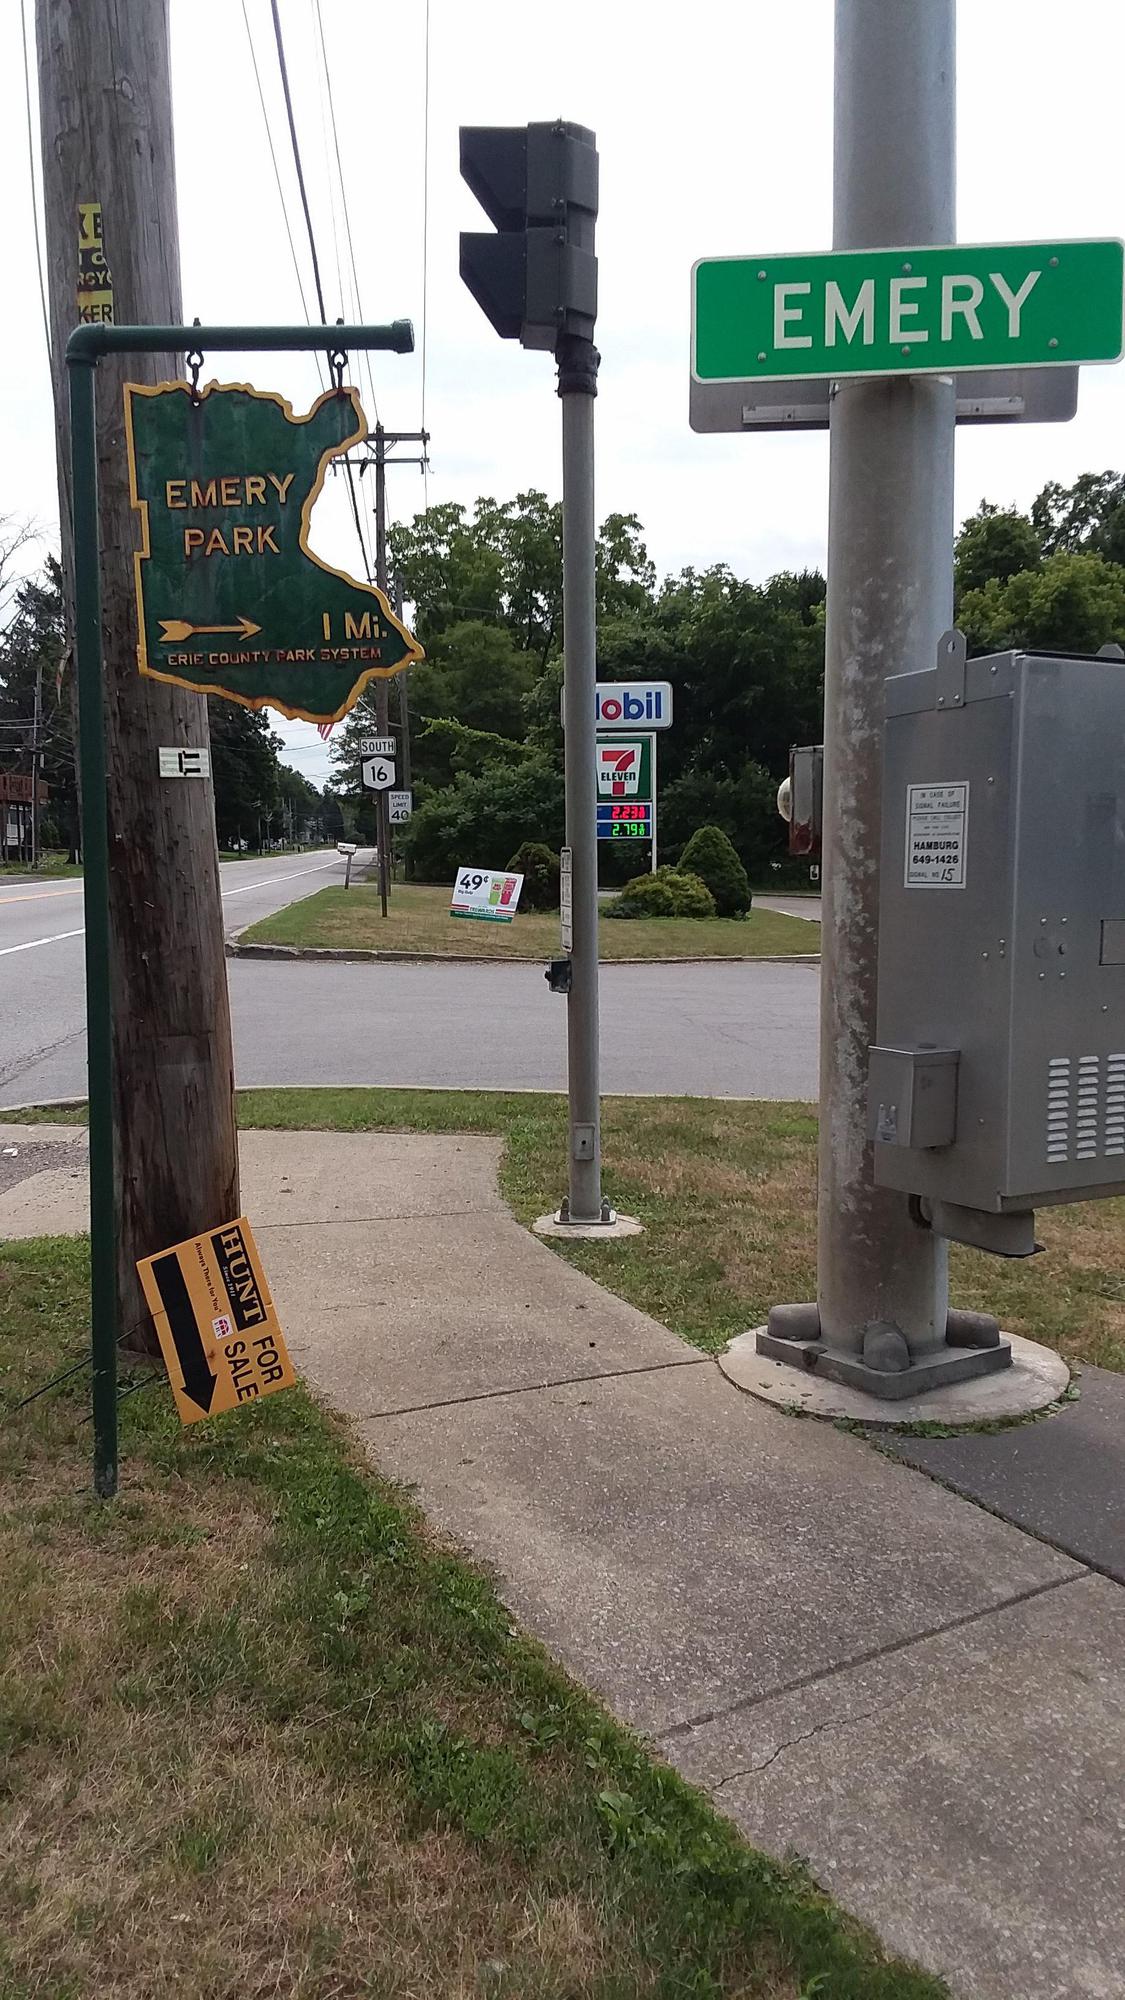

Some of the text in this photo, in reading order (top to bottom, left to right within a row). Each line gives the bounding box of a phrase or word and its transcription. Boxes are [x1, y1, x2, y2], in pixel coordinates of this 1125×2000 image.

[773, 270, 1042, 350] EMERY
[165, 473, 295, 509] EMERY
[184, 525, 281, 557] PARK
[167, 646, 382, 667] ERIE COUNTY PARK SYSTEM
[596, 691, 661, 720] obil
[362, 741, 394, 752] SOUTH
[370, 765, 388, 782] 16
[601, 749, 635, 795] 7
[391, 810, 409, 821] 40
[913, 841, 959, 850] HAMBURG
[941, 868, 955, 881] 15
[194, 1242, 206, 1267] Always
[202, 1265, 214, 1286] There
[220, 1229, 264, 1321] HUNT
[223, 1340, 260, 1402] SALE
[252, 1335, 284, 1385] FOR
